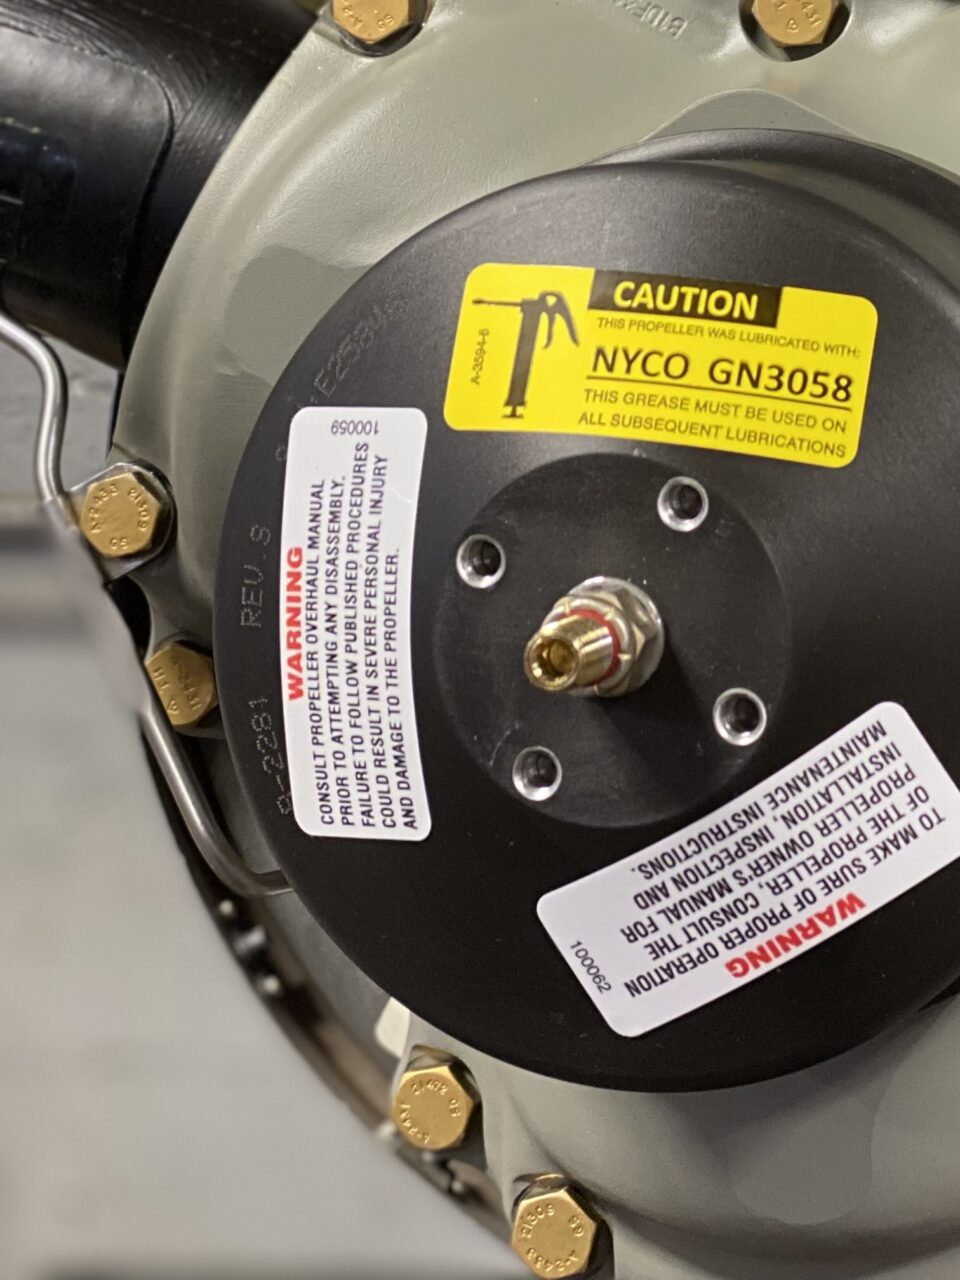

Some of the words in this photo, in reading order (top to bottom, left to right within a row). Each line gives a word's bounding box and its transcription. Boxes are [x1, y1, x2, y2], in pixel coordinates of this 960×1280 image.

[613, 280, 758, 320] CAUTION
[598, 317, 625, 329] THIS
[628, 319, 704, 337] PROPELLER
[708, 327, 736, 341] WAS
[739, 331, 820, 352] LUBRICATED
[824, 343, 861, 358] WITH:
[592, 346, 690, 380] NYCO
[708, 357, 853, 402] GN3058
[330, 420, 379, 435] 100059
[578, 411, 607, 426] ALL
[610, 413, 723, 440] SUBSEQUENT
[725, 426, 847, 458] LUBRICATIONS
[584, 388, 619, 404] THIS
[623, 392, 691, 411] GREASE
[695, 399, 742, 418] MUST
[745, 405, 768, 421] BE
[772, 409, 818, 428] USED
[822, 417, 847, 434] ON
[346, 442, 369, 554] PROCEDURES
[369, 454, 388, 514] INJURY
[307, 479, 325, 550] MANUAL
[325, 476, 346, 595] DISASSEMBLY.
[364, 521, 381, 609] PERSONAL
[286, 546, 304, 701] WARNING
[305, 556, 319, 644] OVERHAUL
[325, 602, 338, 634] ANY
[344, 560, 358, 653] PUBLISHED
[384, 548, 400, 652] PROPELLER.
[364, 615, 378, 679] SEVERE
[306, 651, 325, 746] PROPELLER
[325, 641, 344, 744] ATTEMPTING
[346, 660, 362, 729] FOLLOW
[366, 685, 380, 701] IN
[385, 661, 398, 689] THE
[387, 696, 400, 716] TO
[333, 750, 347, 770] TO
[350, 735, 365, 755] TO
[368, 707, 387, 769] RESULT
[390, 723, 411, 790] DAMAGE
[764, 720, 887, 810] MAINTENANCE
[312, 752, 334, 825] CONSULT
[336, 776, 355, 826] PRIOR
[354, 760, 375, 827] FAILURE
[376, 775, 397, 828] COULD
[774, 742, 902, 829] INSTALLATION,
[814, 763, 916, 837] PROPELLER
[906, 785, 930, 811] OF
[400, 797, 418, 830] AND
[866, 804, 905, 835] THE
[919, 808, 946, 831] TO
[631, 802, 765, 880] INSTRUCTIONS.
[670, 825, 775, 892] INSPECTION
[732, 830, 814, 887] OWNER'S
[758, 826, 868, 896] PROPELLER,
[865, 824, 919, 866] MAKE
[633, 881, 670, 910] AND
[657, 878, 733, 924] MANUAL
[794, 887, 818, 912] OF
[816, 857, 867, 896] SURE
[620, 916, 659, 943] FOR
[681, 892, 760, 944] CONSULT
[718, 902, 792, 950] PROPER
[725, 892, 867, 978] WARNING
[570, 940, 612, 993] 100062
[624, 942, 719, 998] OPERATION
[643, 934, 682, 961] THE
